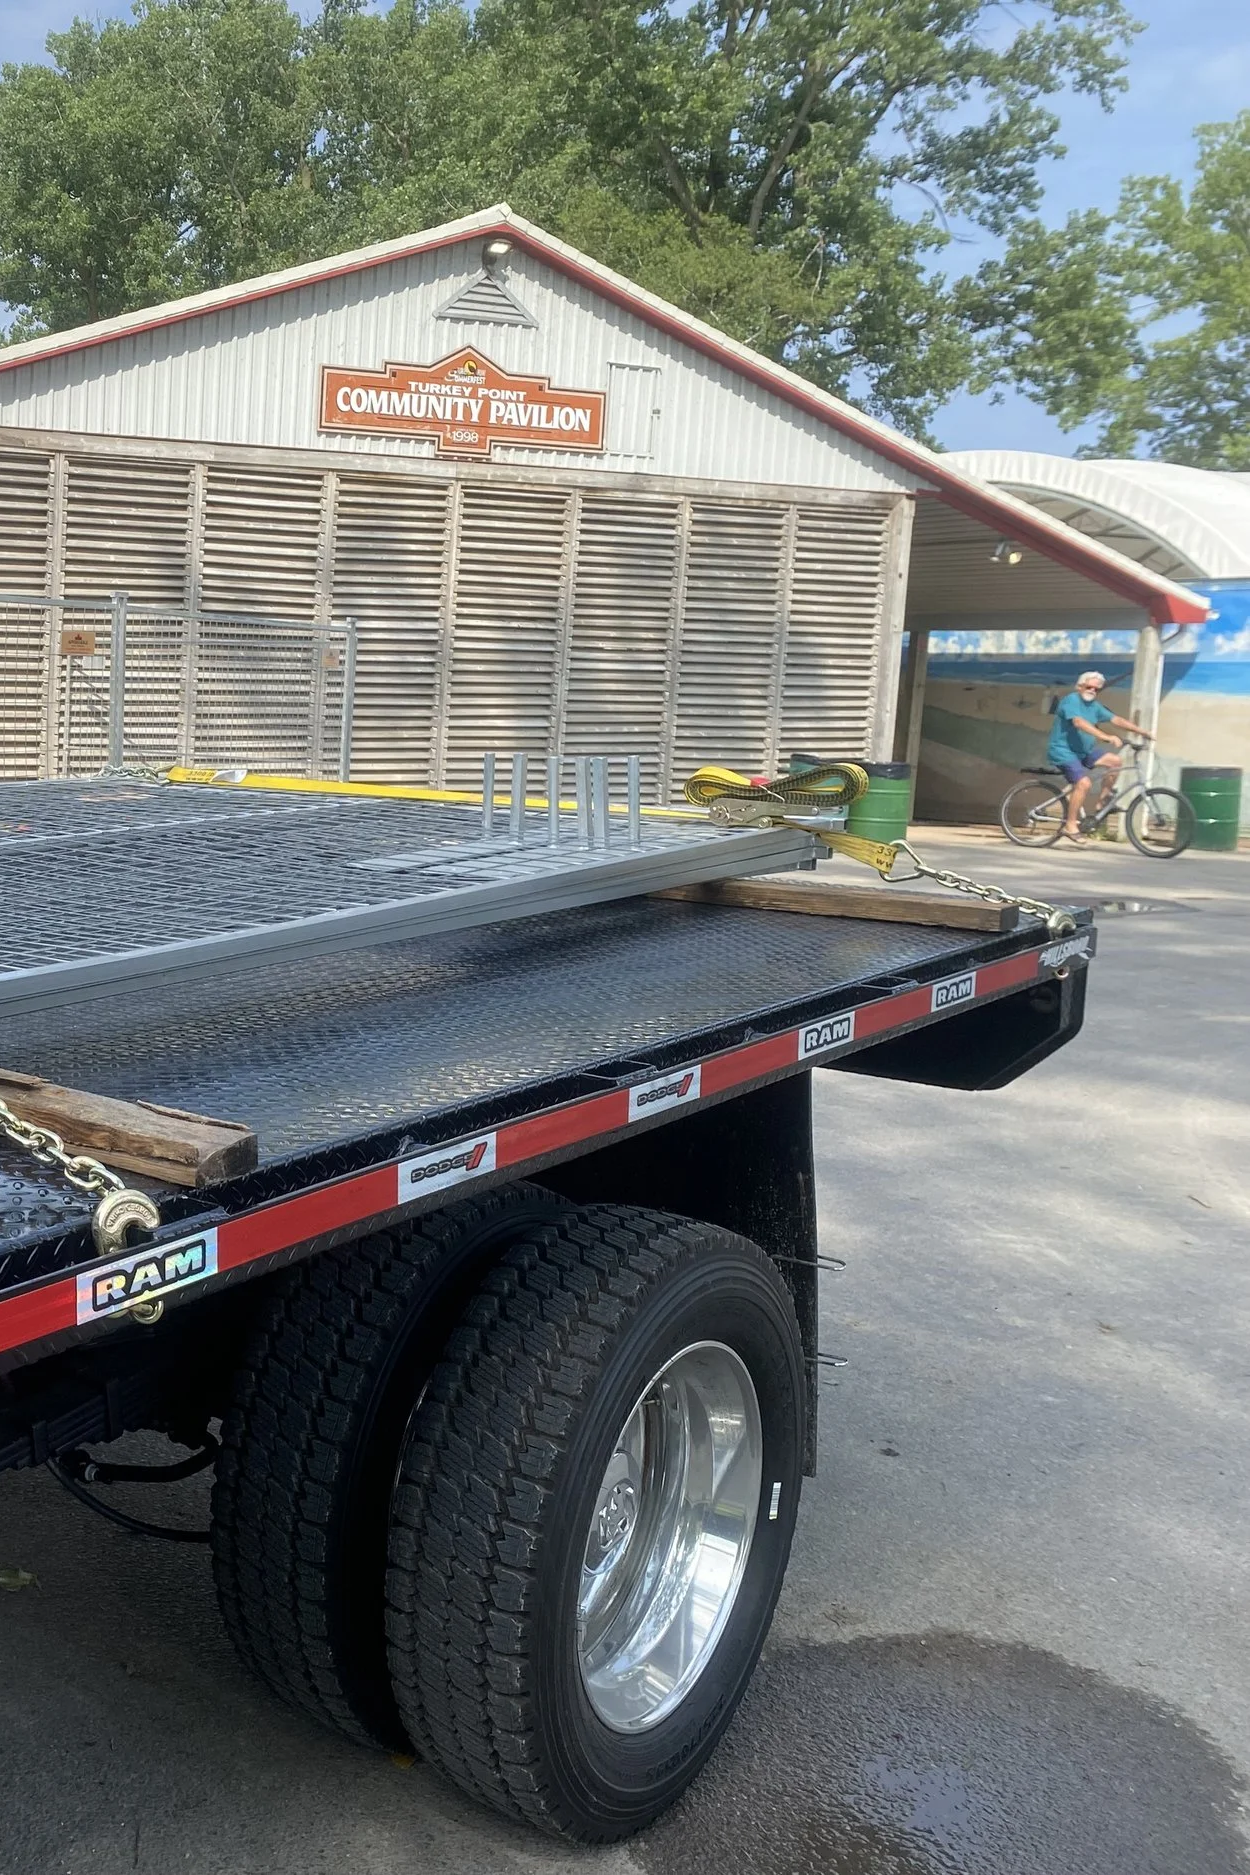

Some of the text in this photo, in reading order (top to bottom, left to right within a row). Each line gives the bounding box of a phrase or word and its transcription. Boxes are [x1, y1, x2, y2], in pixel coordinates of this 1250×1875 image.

[408, 381, 527, 402] TURKEY POINT
[336, 387, 592, 432] COMMUNITY PAVILION
[452, 430, 479, 443] 1998
[936, 976, 973, 1007] RAM
[805, 1017, 850, 1053] RAM
[92, 1238, 206, 1312] RAM
